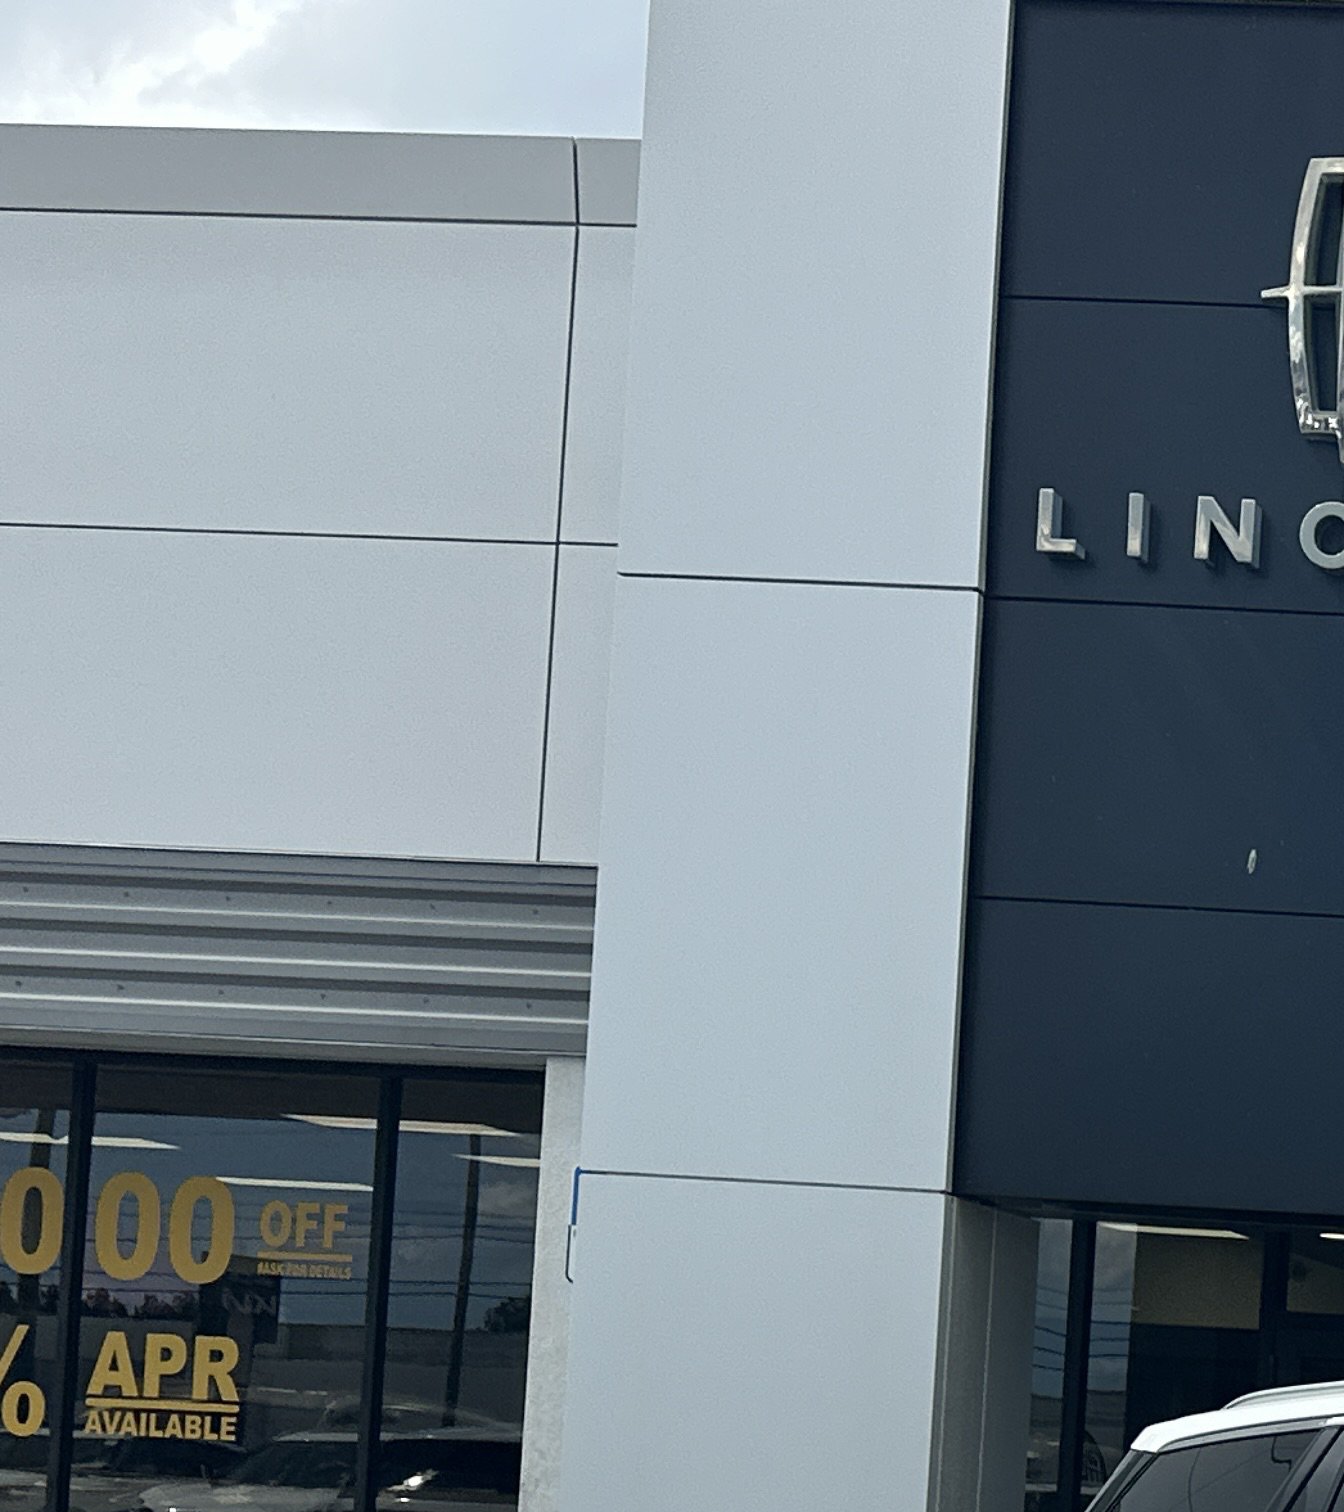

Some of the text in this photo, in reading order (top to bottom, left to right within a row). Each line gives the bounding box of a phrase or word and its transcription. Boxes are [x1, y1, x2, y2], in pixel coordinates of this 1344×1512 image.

[260, 1199, 349, 1248] OFF
[86, 1331, 241, 1401] APR
[85, 1411, 237, 1441] AVAILABLE
